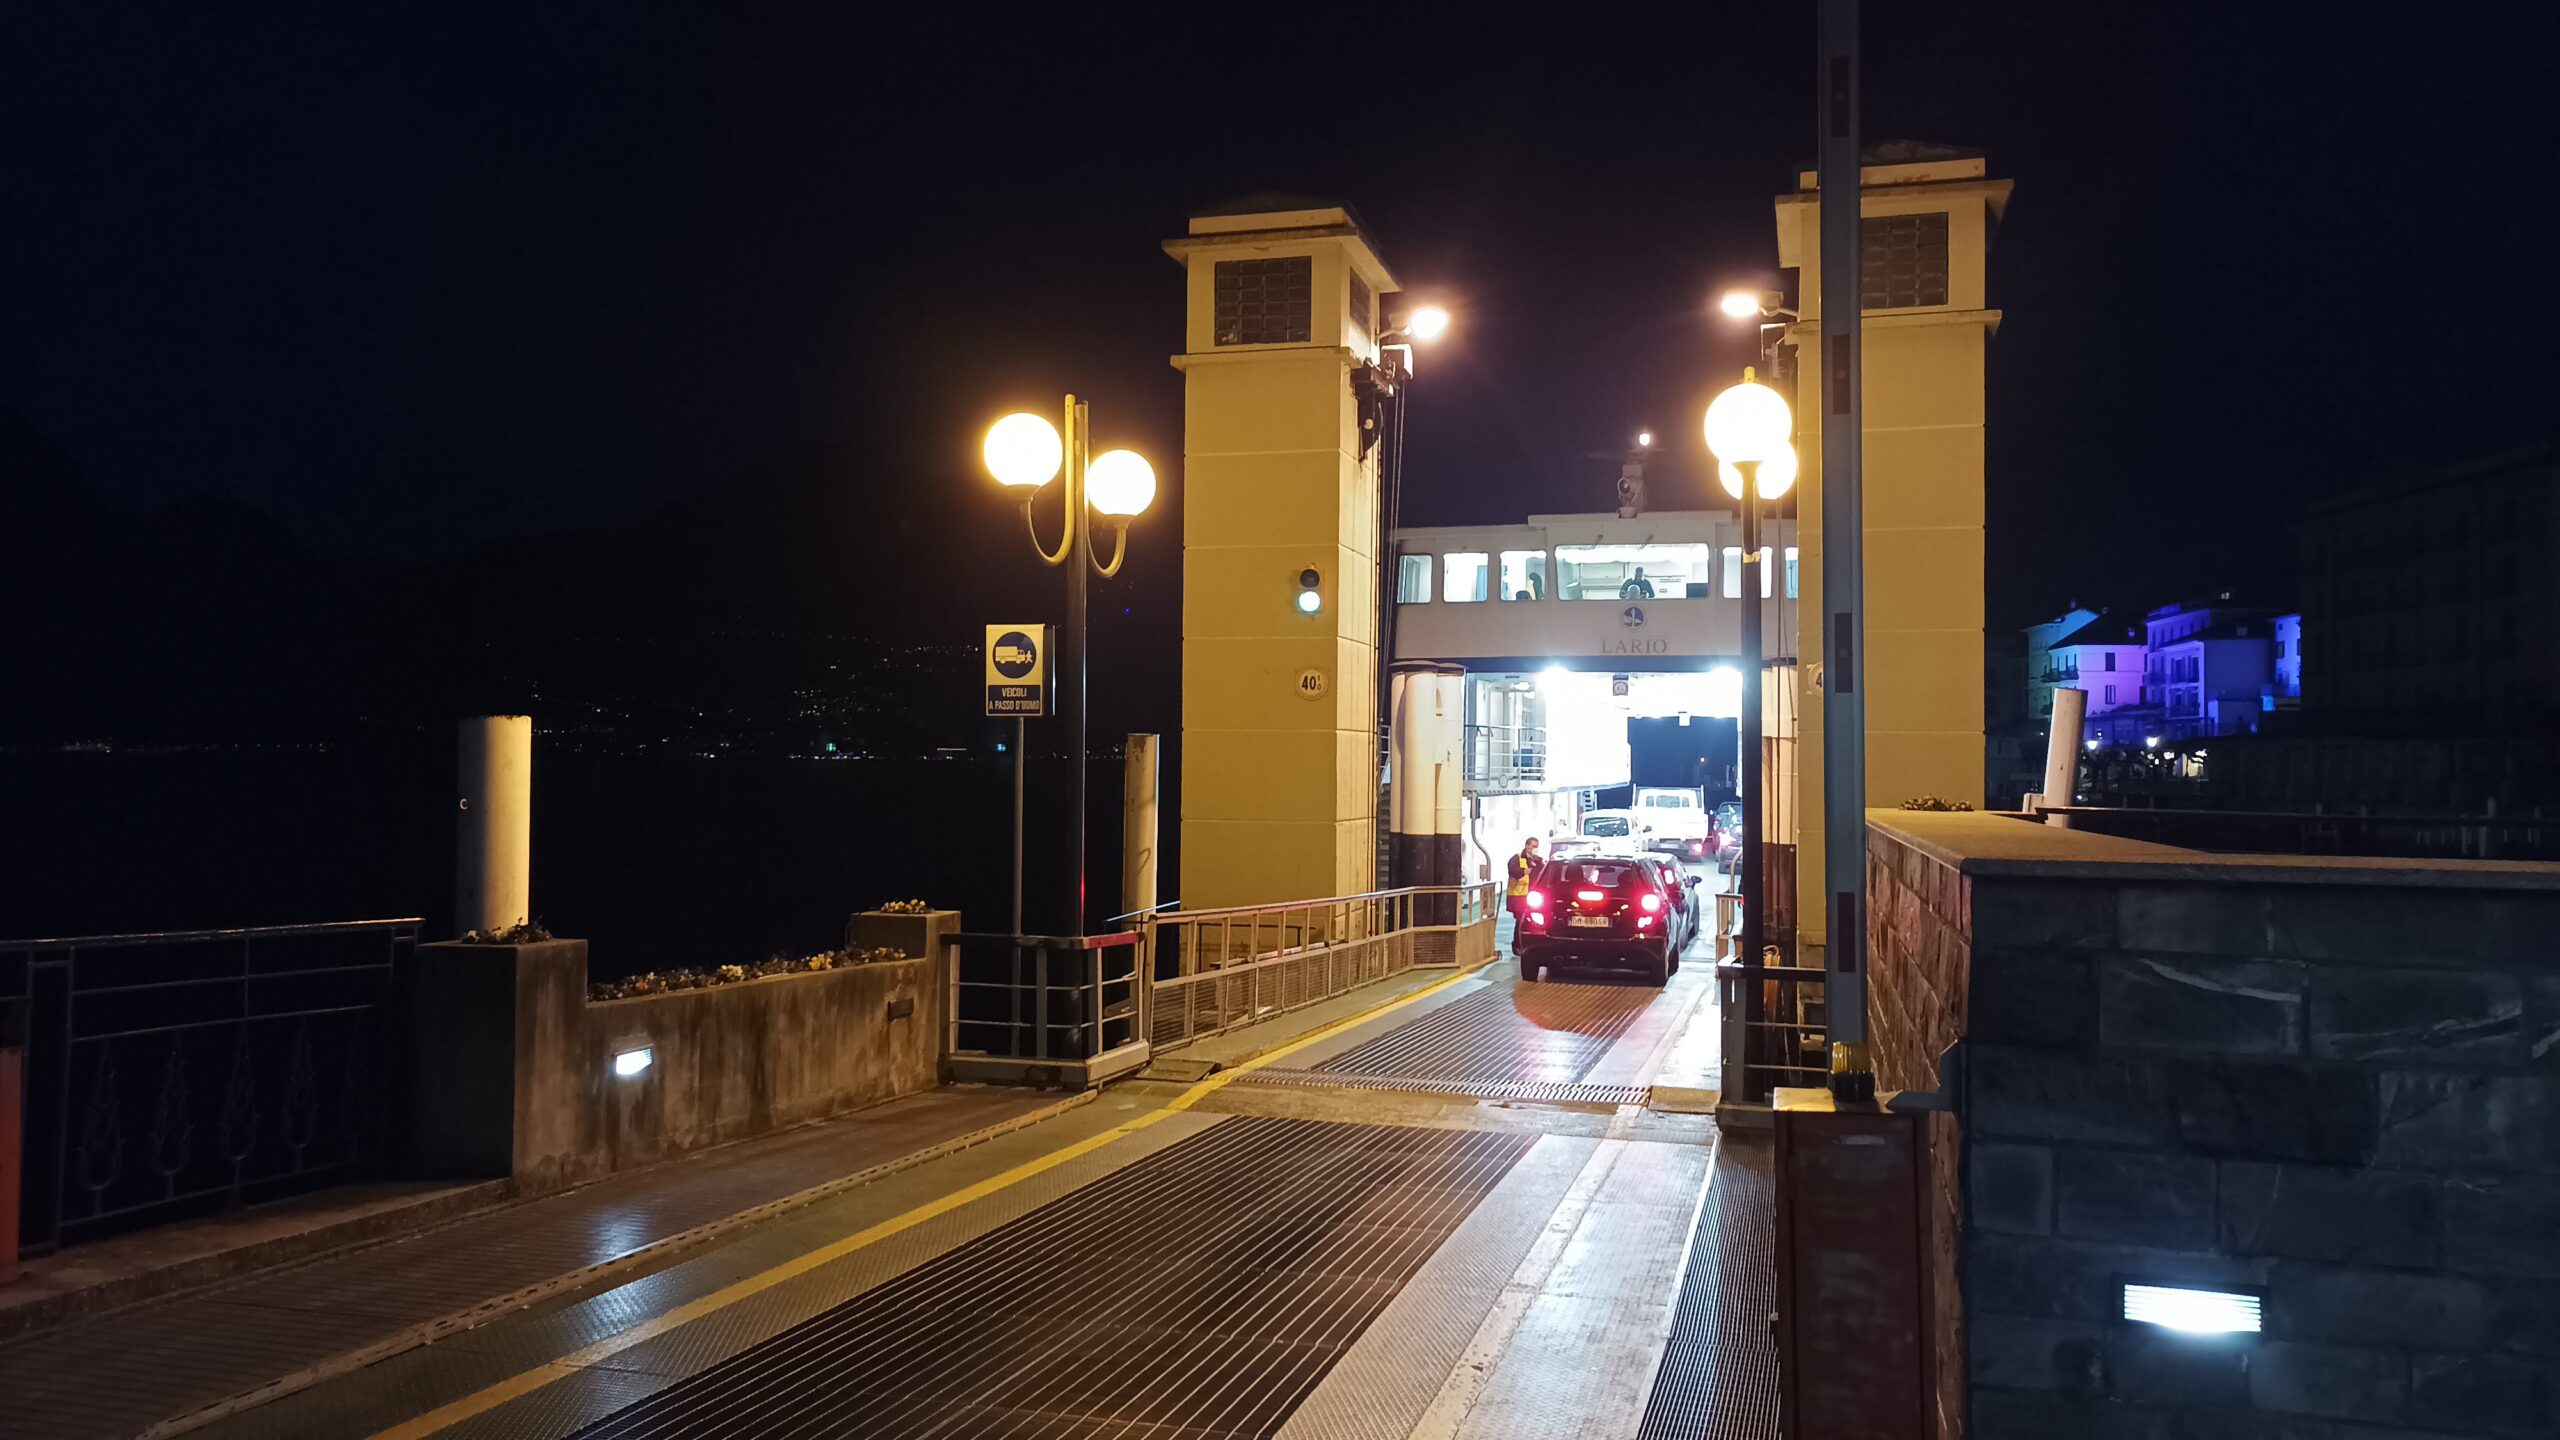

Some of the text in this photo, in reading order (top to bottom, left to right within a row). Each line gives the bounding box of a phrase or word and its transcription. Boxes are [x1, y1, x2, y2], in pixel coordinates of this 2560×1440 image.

[1601, 639, 1667, 654] LARIO
[1002, 687, 1027, 697] VEICOLI
[989, 700, 1040, 710] A PASSO D'UOMO
